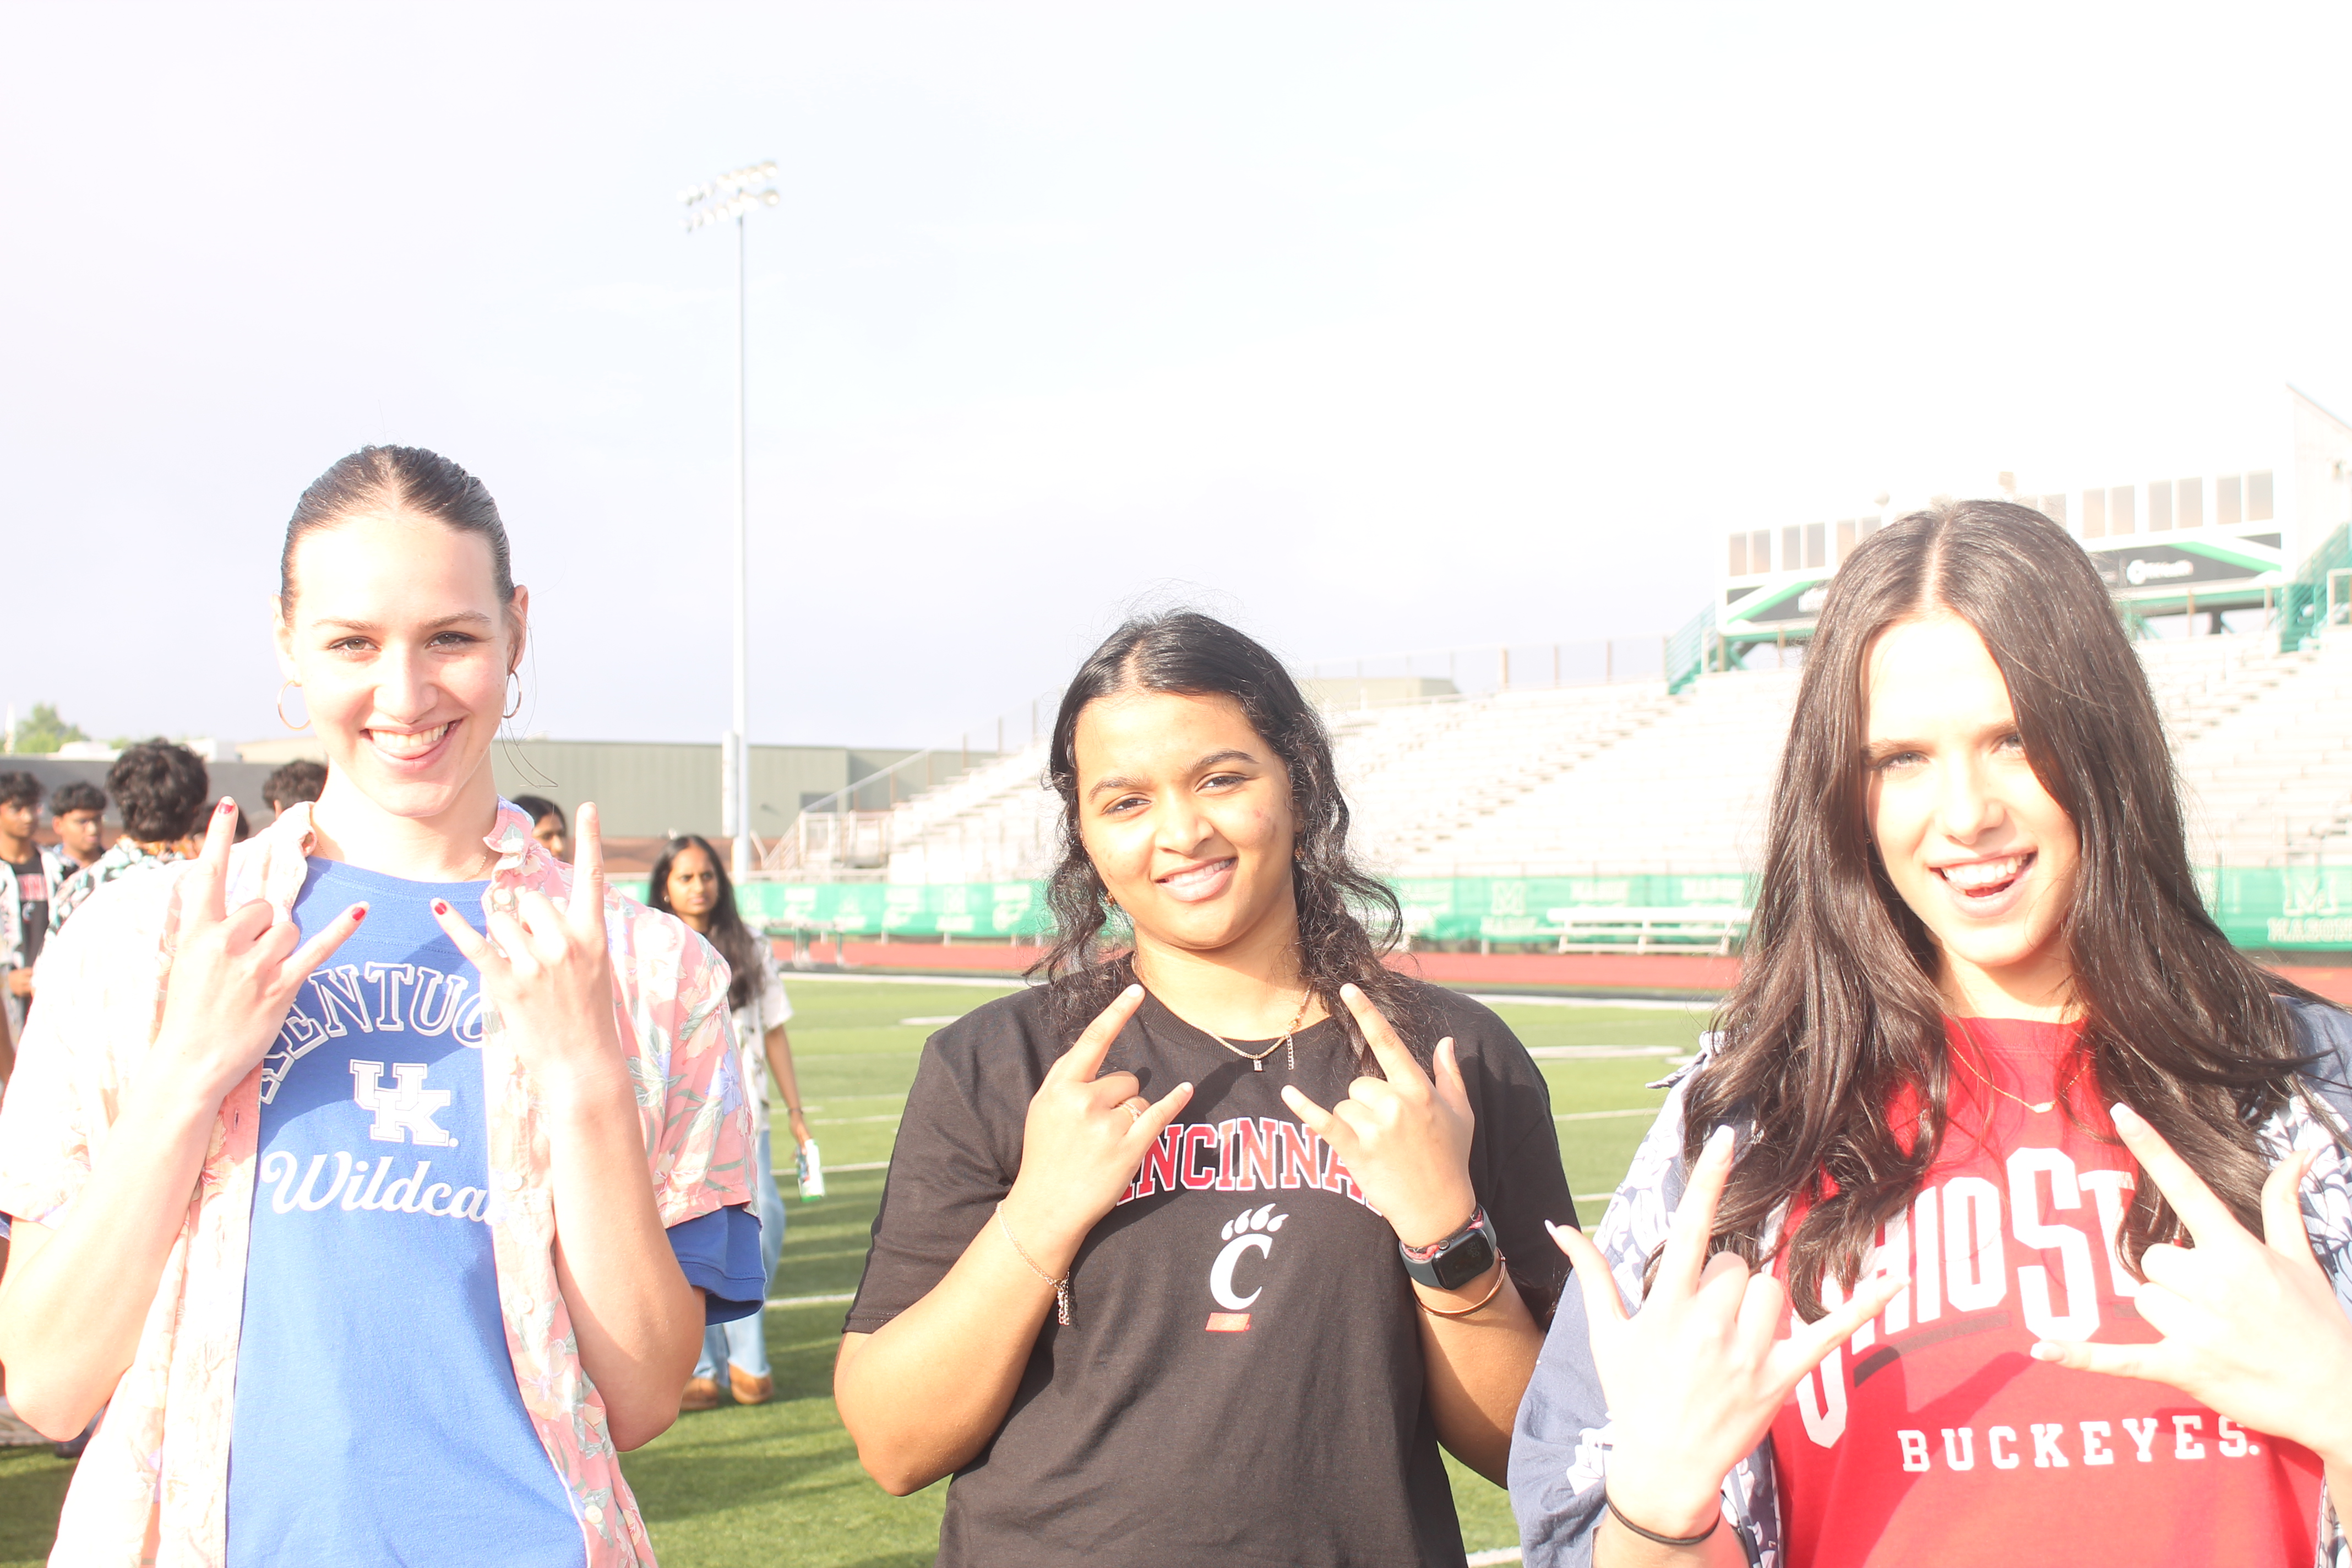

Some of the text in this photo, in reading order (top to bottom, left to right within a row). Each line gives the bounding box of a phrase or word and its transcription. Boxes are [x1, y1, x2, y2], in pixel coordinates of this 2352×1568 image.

[260, 961, 484, 1105] ENTUC
[260, 1150, 489, 1223] Wildca
[1116, 1117, 1382, 1217] NCINNA
